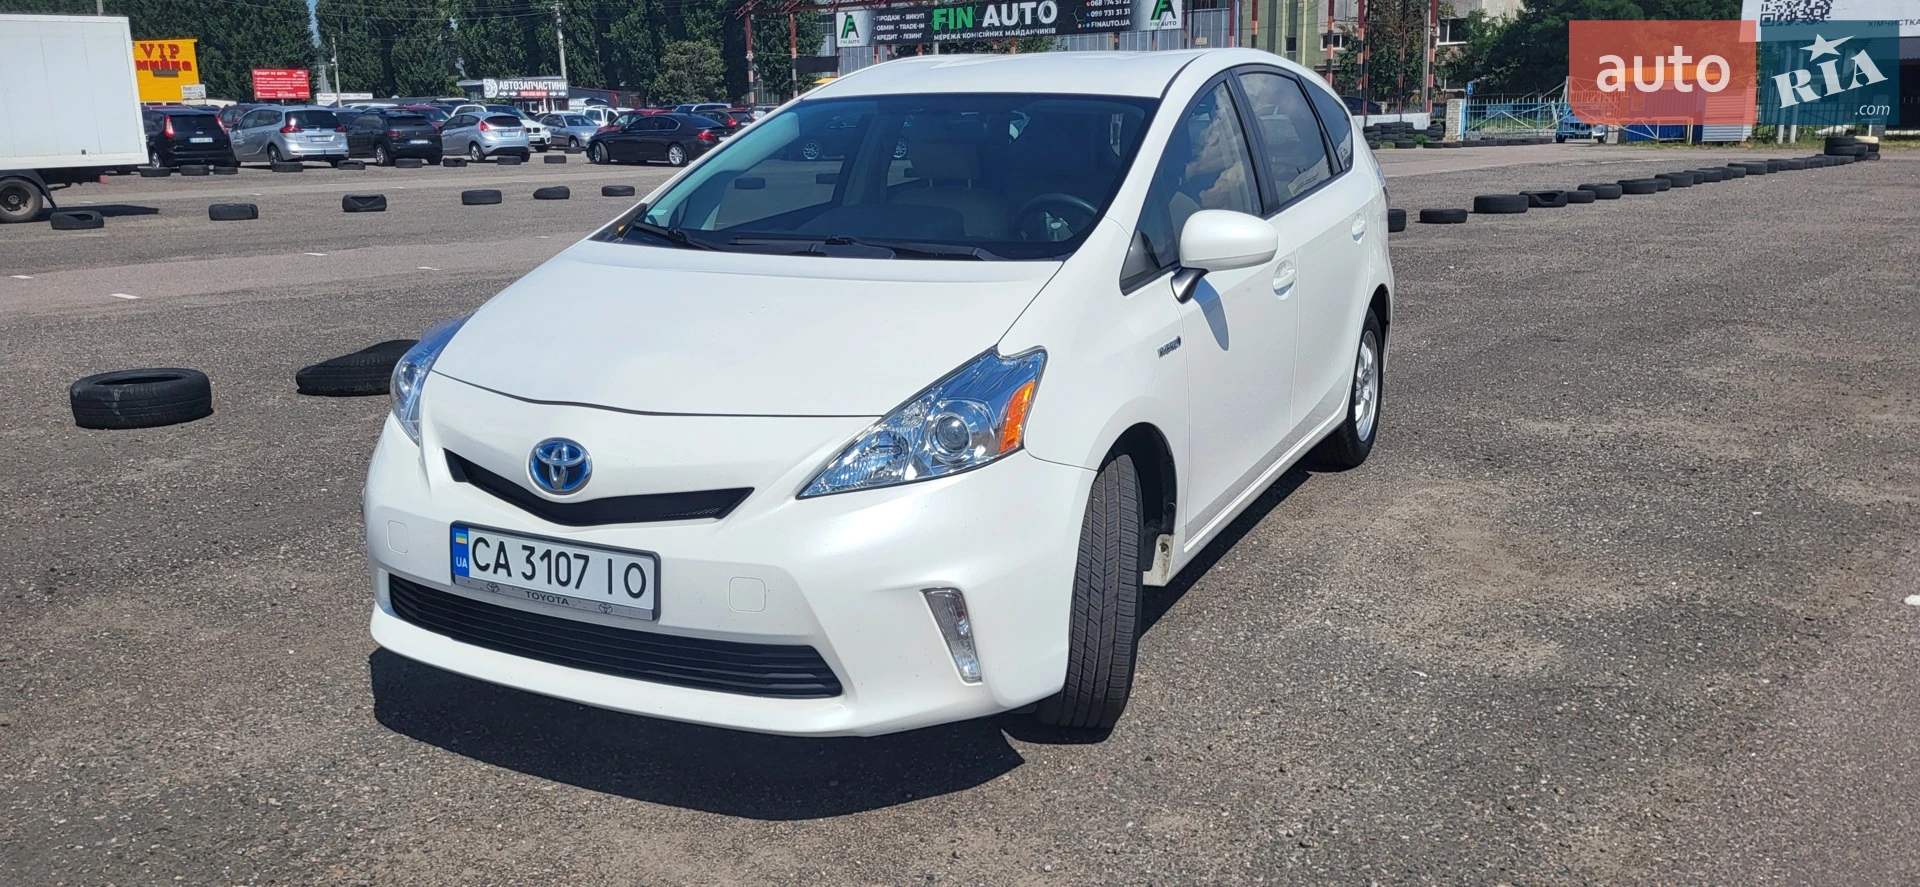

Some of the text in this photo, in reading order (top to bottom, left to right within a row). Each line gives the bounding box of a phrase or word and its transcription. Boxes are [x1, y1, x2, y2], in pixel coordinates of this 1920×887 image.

[934, 0, 1058, 30] FIN AUTO
[1091, 19, 1131, 28] FINAUTO.UA
[962, 30, 1003, 39] КОМІСІЙНИХ
[1005, 28, 1056, 36] МАЙДАНЧИКІВ
[140, 44, 180, 59] VIP
[499, 81, 567, 90] АВТОЗАПЧАСТИНИ
[456, 556, 468, 568] UA
[472, 537, 647, 599] CA 3107 IO
[525, 590, 570, 606] TOYOTA
